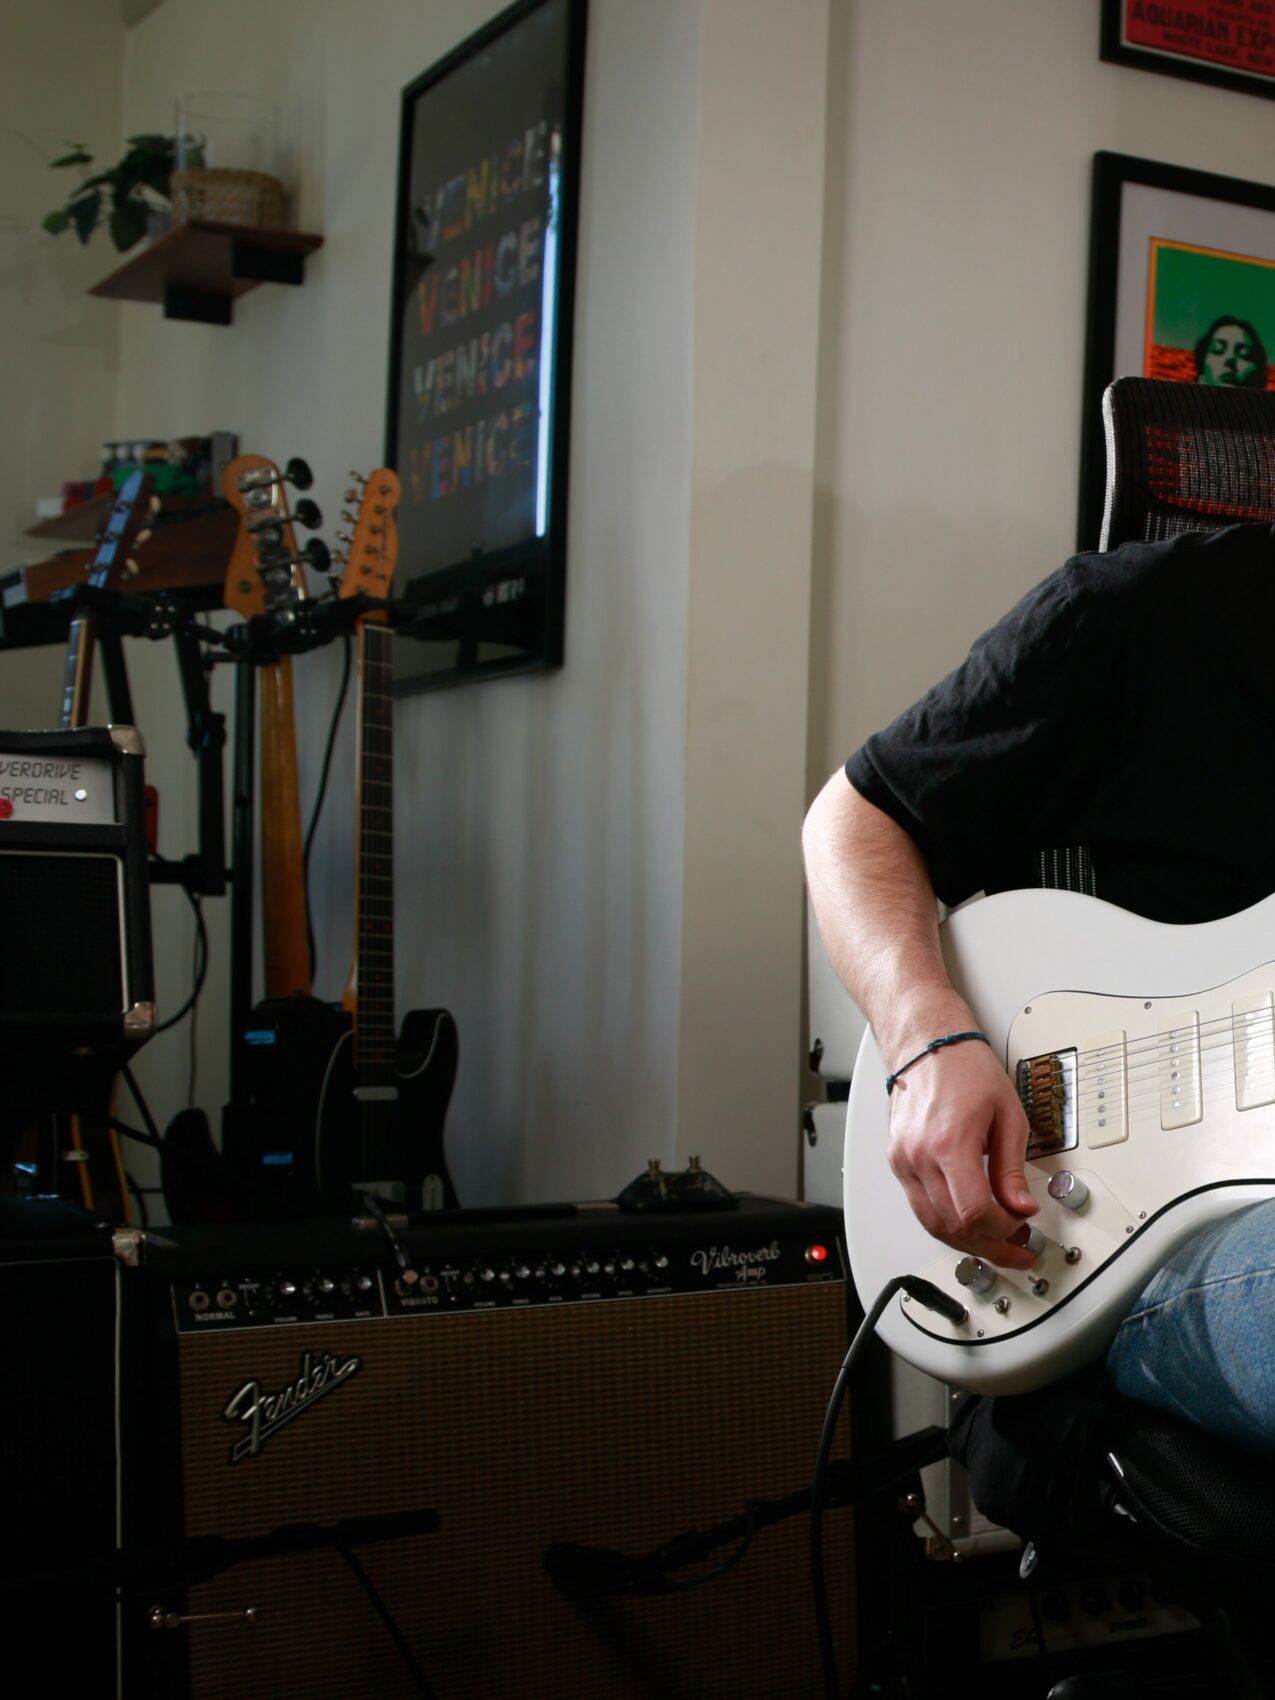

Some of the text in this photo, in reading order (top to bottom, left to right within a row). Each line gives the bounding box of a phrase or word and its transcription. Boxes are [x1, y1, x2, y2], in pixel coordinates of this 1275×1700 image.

[1132, 1, 1229, 41] AQUARIAN
[418, 215, 541, 336] VENICE
[413, 309, 537, 423] VENICE
[408, 401, 532, 503] VENICE
[1, 786, 68, 805] SPECIAL
[689, 1239, 780, 1276] Vibroverb
[734, 1265, 767, 1281] Amp
[194, 1311, 236, 1321] NORMAL
[400, 1296, 439, 1306] VIBRATO
[224, 1353, 359, 1456] Fender
